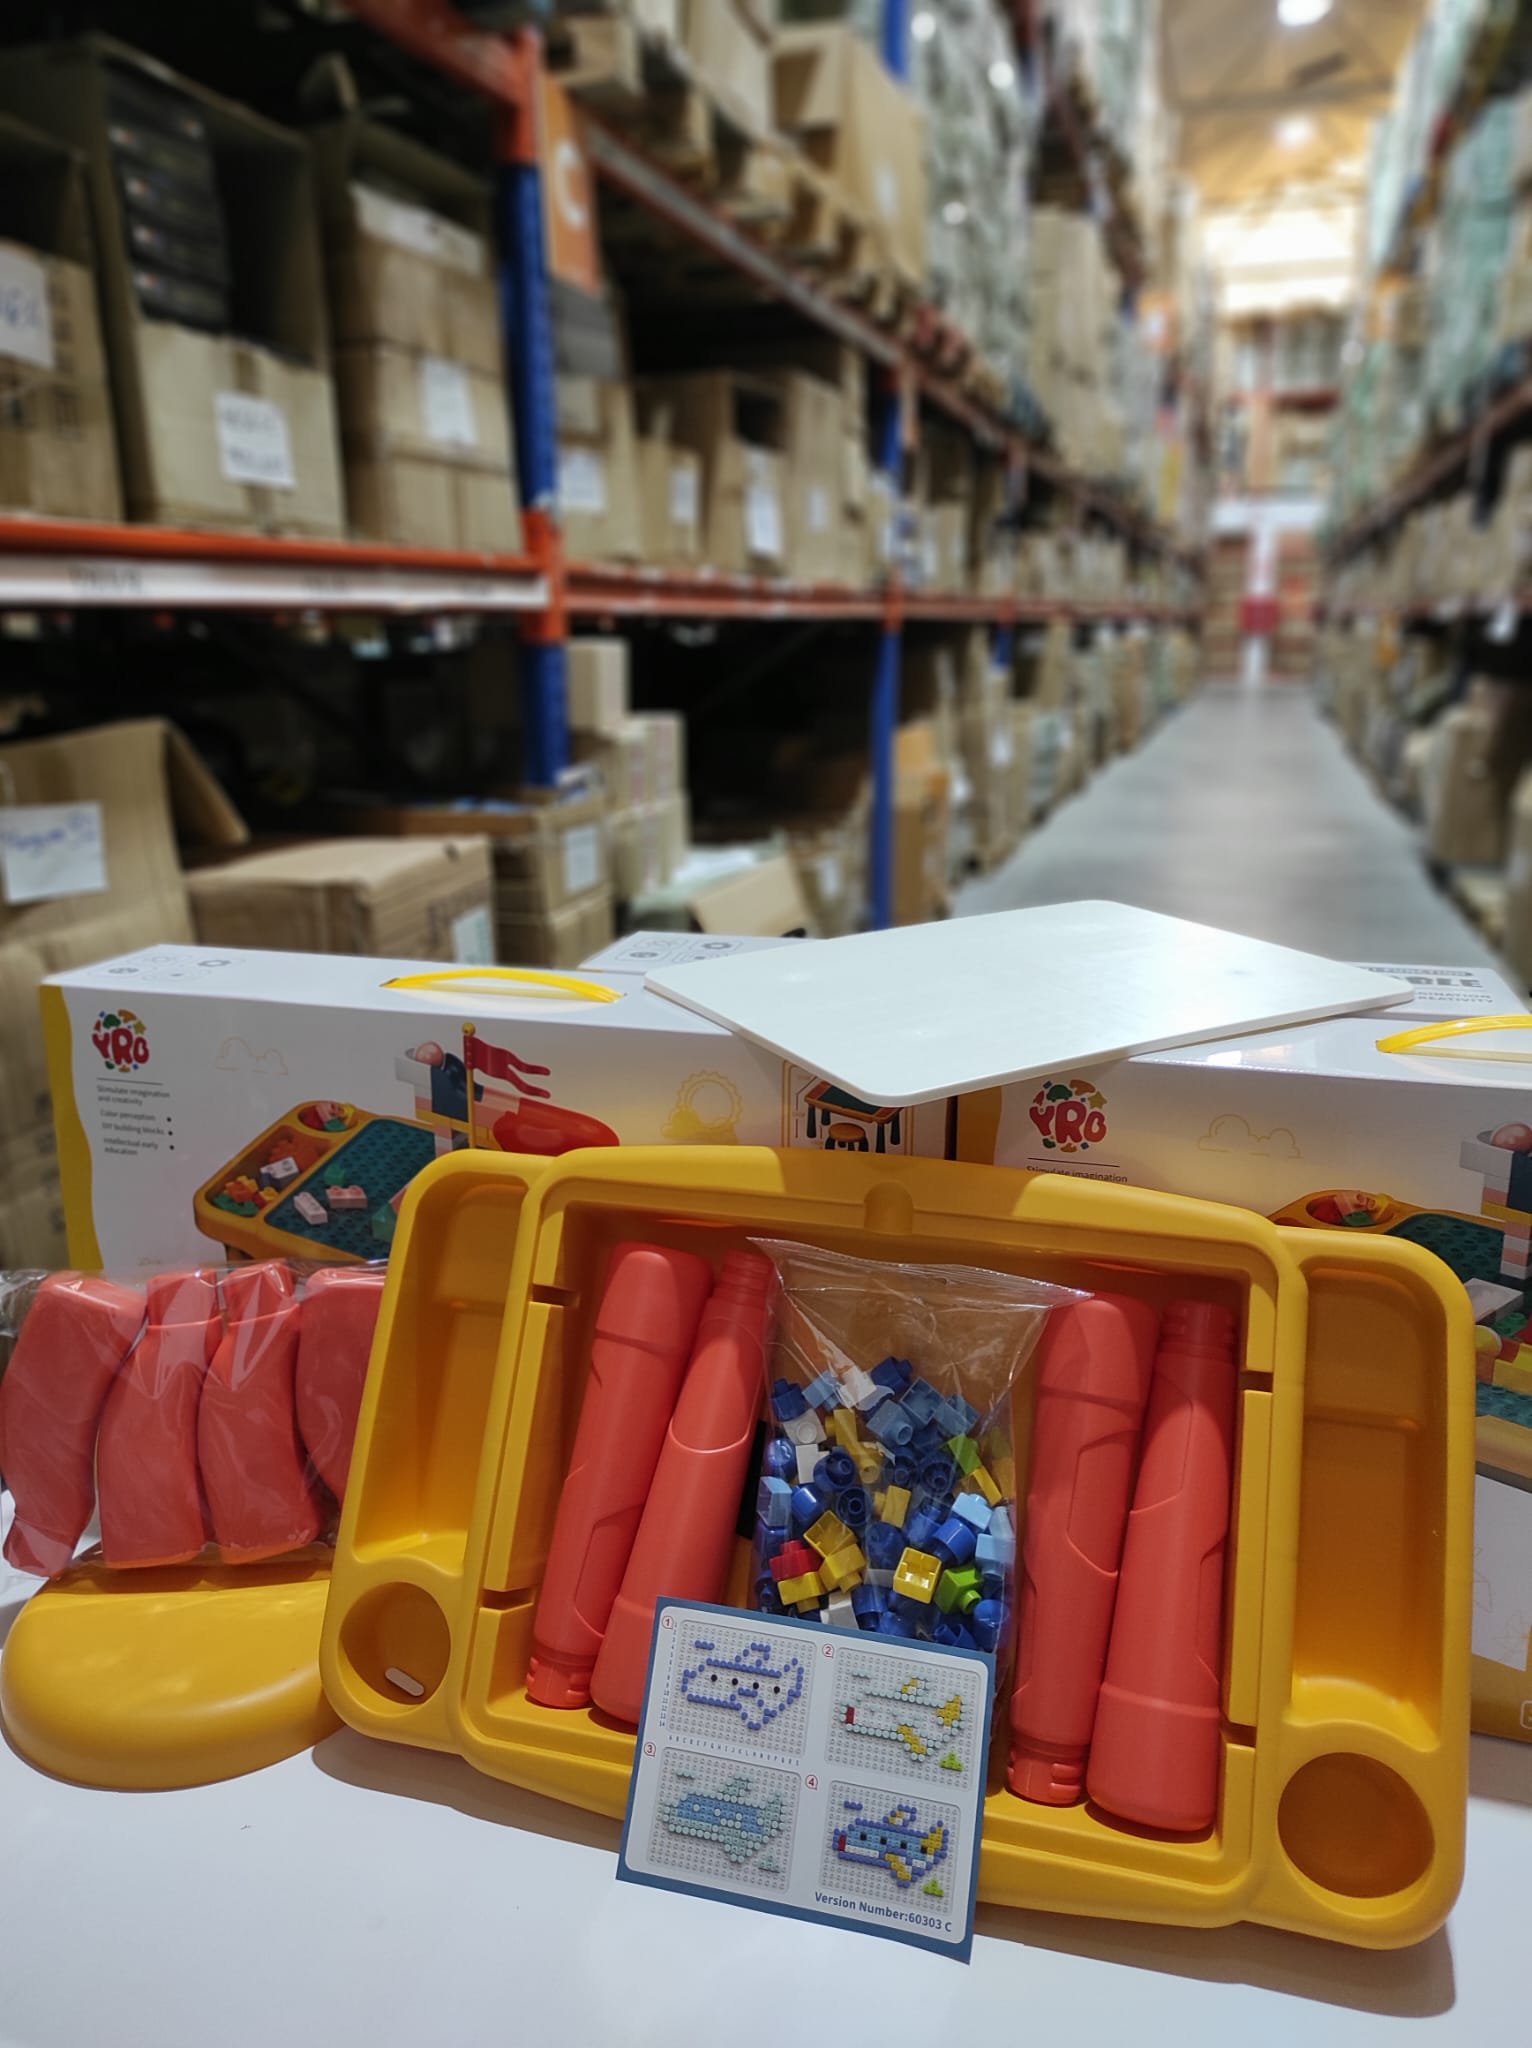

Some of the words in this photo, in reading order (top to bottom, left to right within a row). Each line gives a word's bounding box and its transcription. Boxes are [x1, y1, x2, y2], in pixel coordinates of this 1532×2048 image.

[815, 1891, 856, 1910] Version
[859, 1901, 942, 1930] Number:60303
[944, 1922, 952, 1932] C
